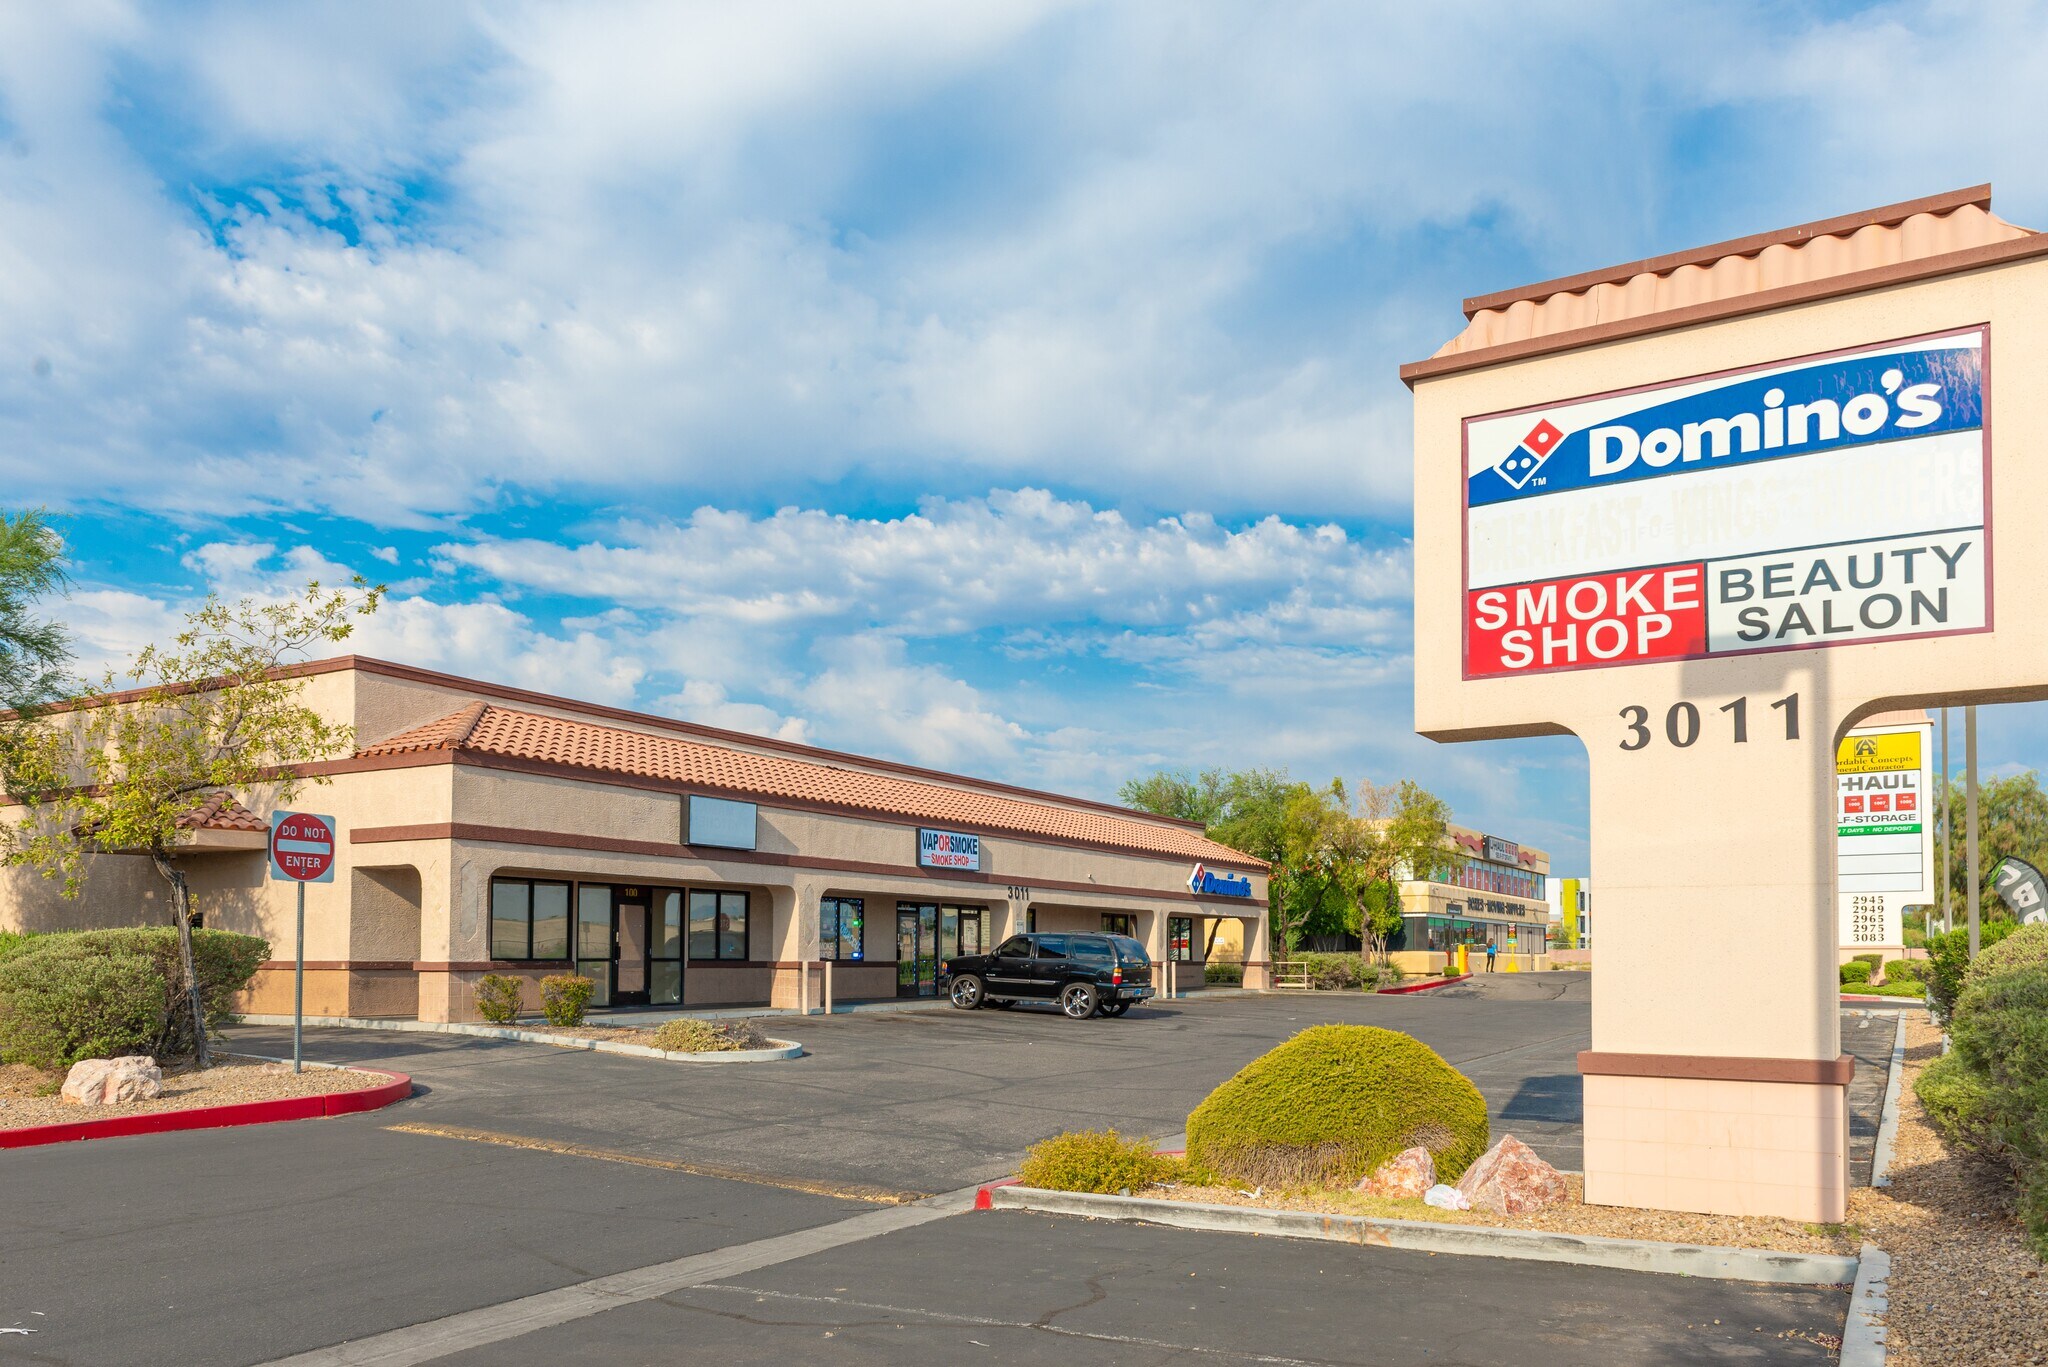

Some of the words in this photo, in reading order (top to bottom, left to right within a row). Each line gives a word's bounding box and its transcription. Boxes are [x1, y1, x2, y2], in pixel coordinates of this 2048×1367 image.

[1588, 369, 1942, 478] Domino's
[1531, 477, 1547, 487] TM
[1719, 541, 1973, 604] BEAUTY
[1475, 567, 1700, 631] SMOKE
[1736, 586, 1948, 643] SALON
[1500, 613, 1673, 669] SHOP
[1618, 692, 1801, 752] 3011
[1870, 756, 1913, 764] Concepts
[1862, 764, 1905, 772] Contractor
[1836, 774, 1915, 791] -HAUL
[282, 825, 297, 837] DO
[304, 827, 326, 839] NOT
[922, 832, 978, 855] VAPORSMOKE
[286, 855, 321, 869] ENTER
[931, 853, 952, 866] SMOKE
[953, 855, 969, 867] SHOP
[625, 888, 638, 897] 100
[1007, 885, 1029, 901] 3011
[1852, 895, 1884, 904] 2945
[1852, 905, 1884, 914] 2949
[1852, 914, 1884, 924] 2965
[1853, 924, 1885, 933] 2975
[1853, 933, 1885, 942] 3083
